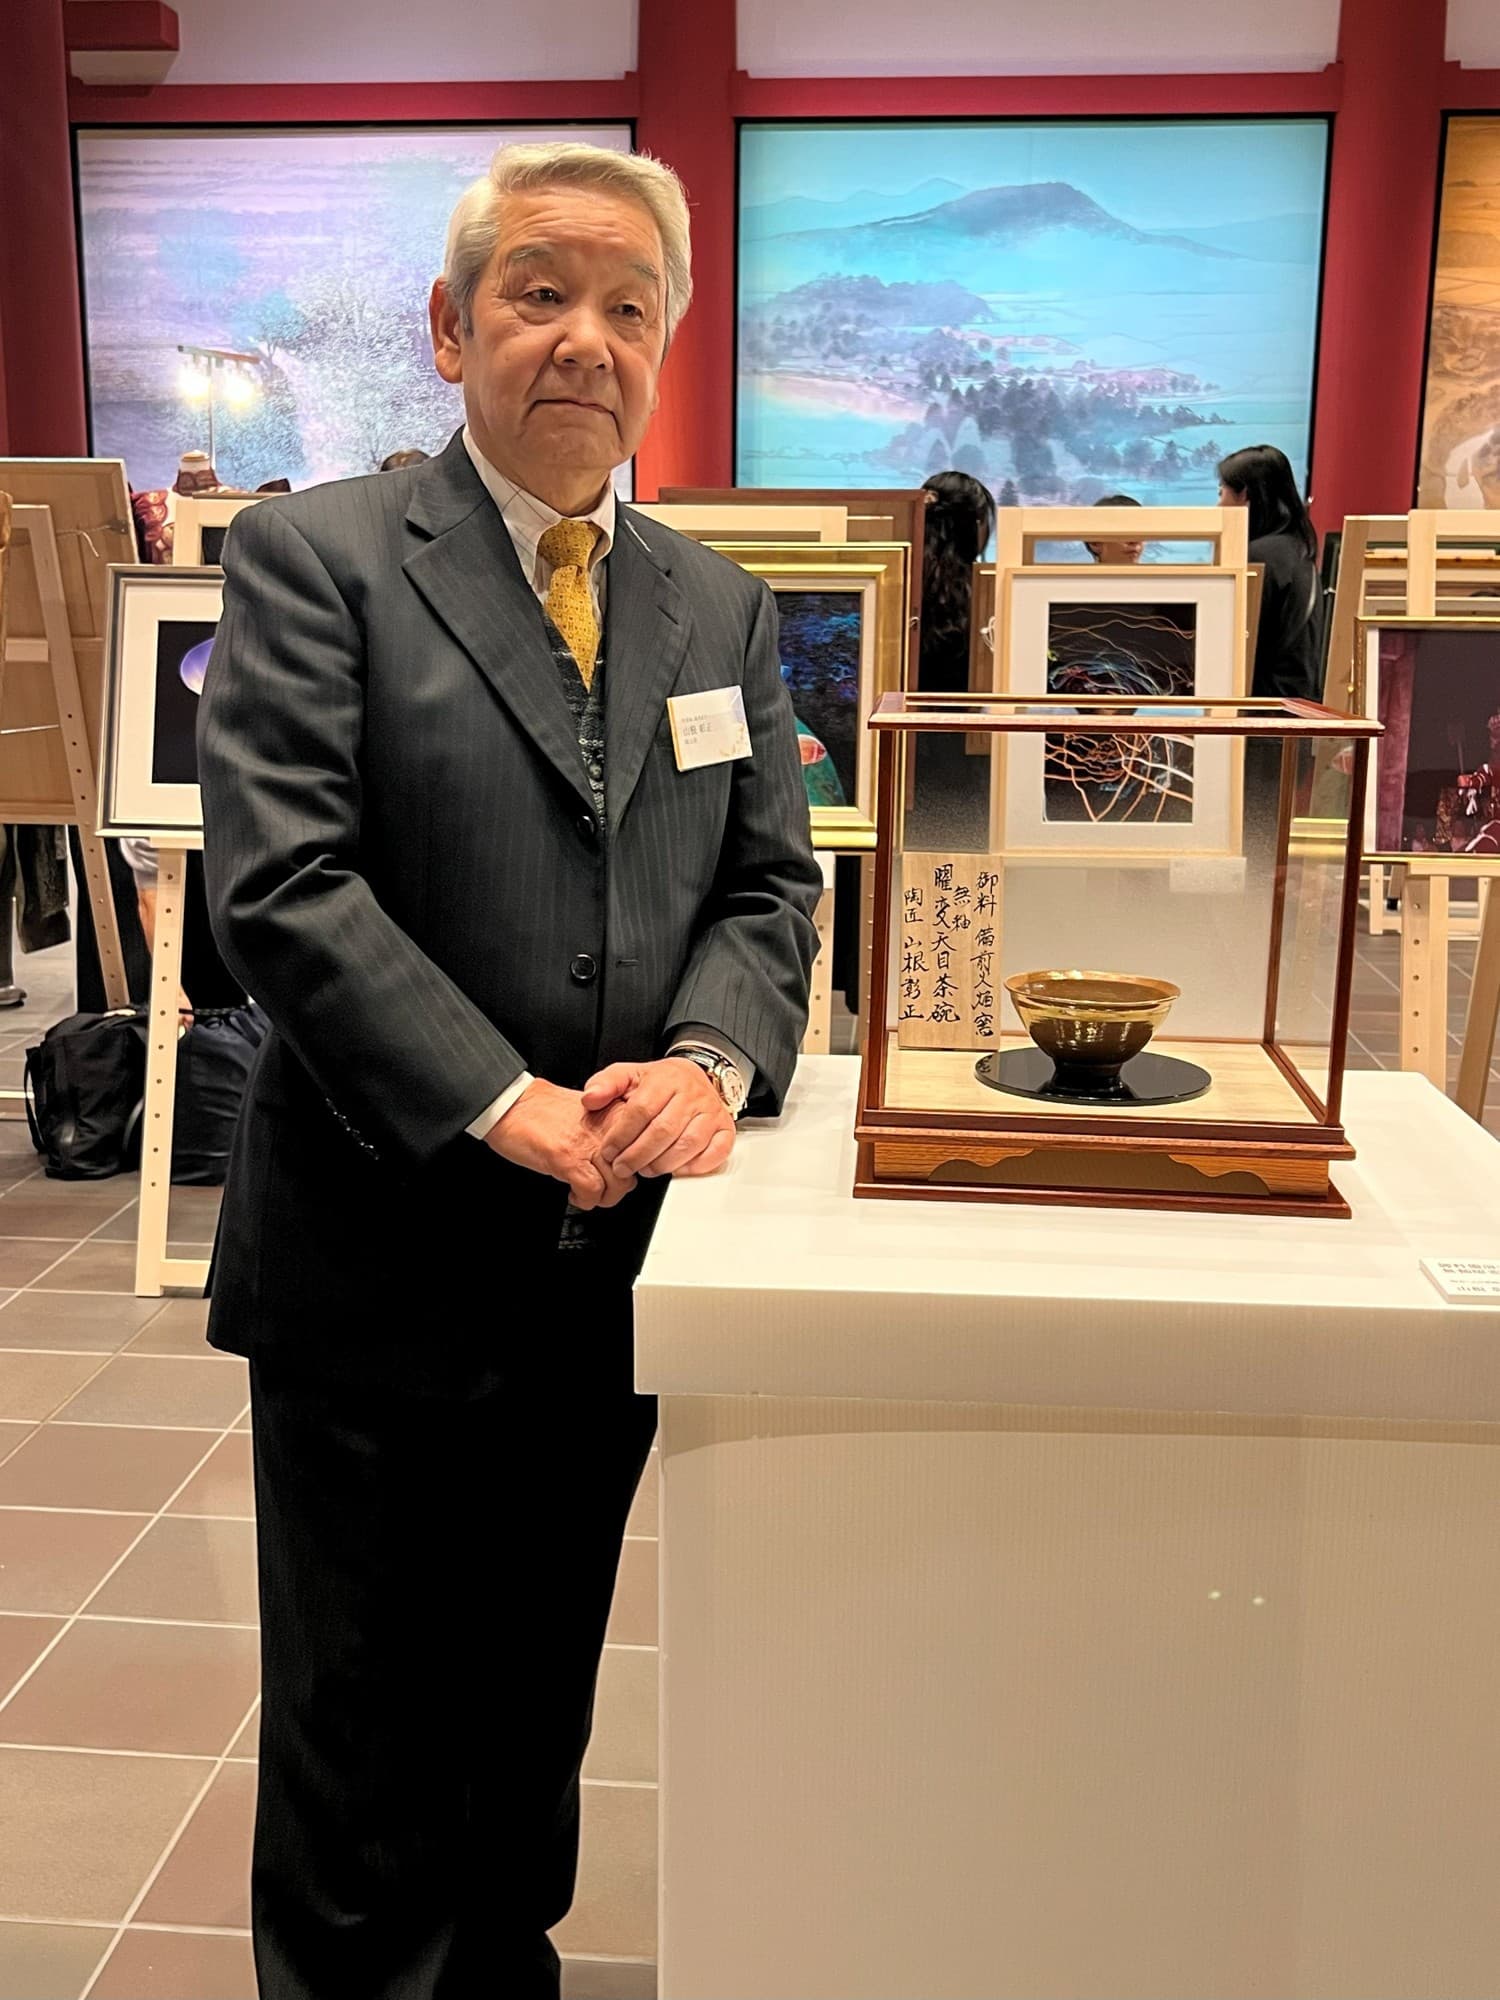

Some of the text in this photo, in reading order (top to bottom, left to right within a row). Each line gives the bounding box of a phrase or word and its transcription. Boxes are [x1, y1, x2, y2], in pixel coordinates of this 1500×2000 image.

[898, 887, 929, 1021] 陶匠 山根彰正
[926, 863, 961, 1023] 曜変天目茶碗
